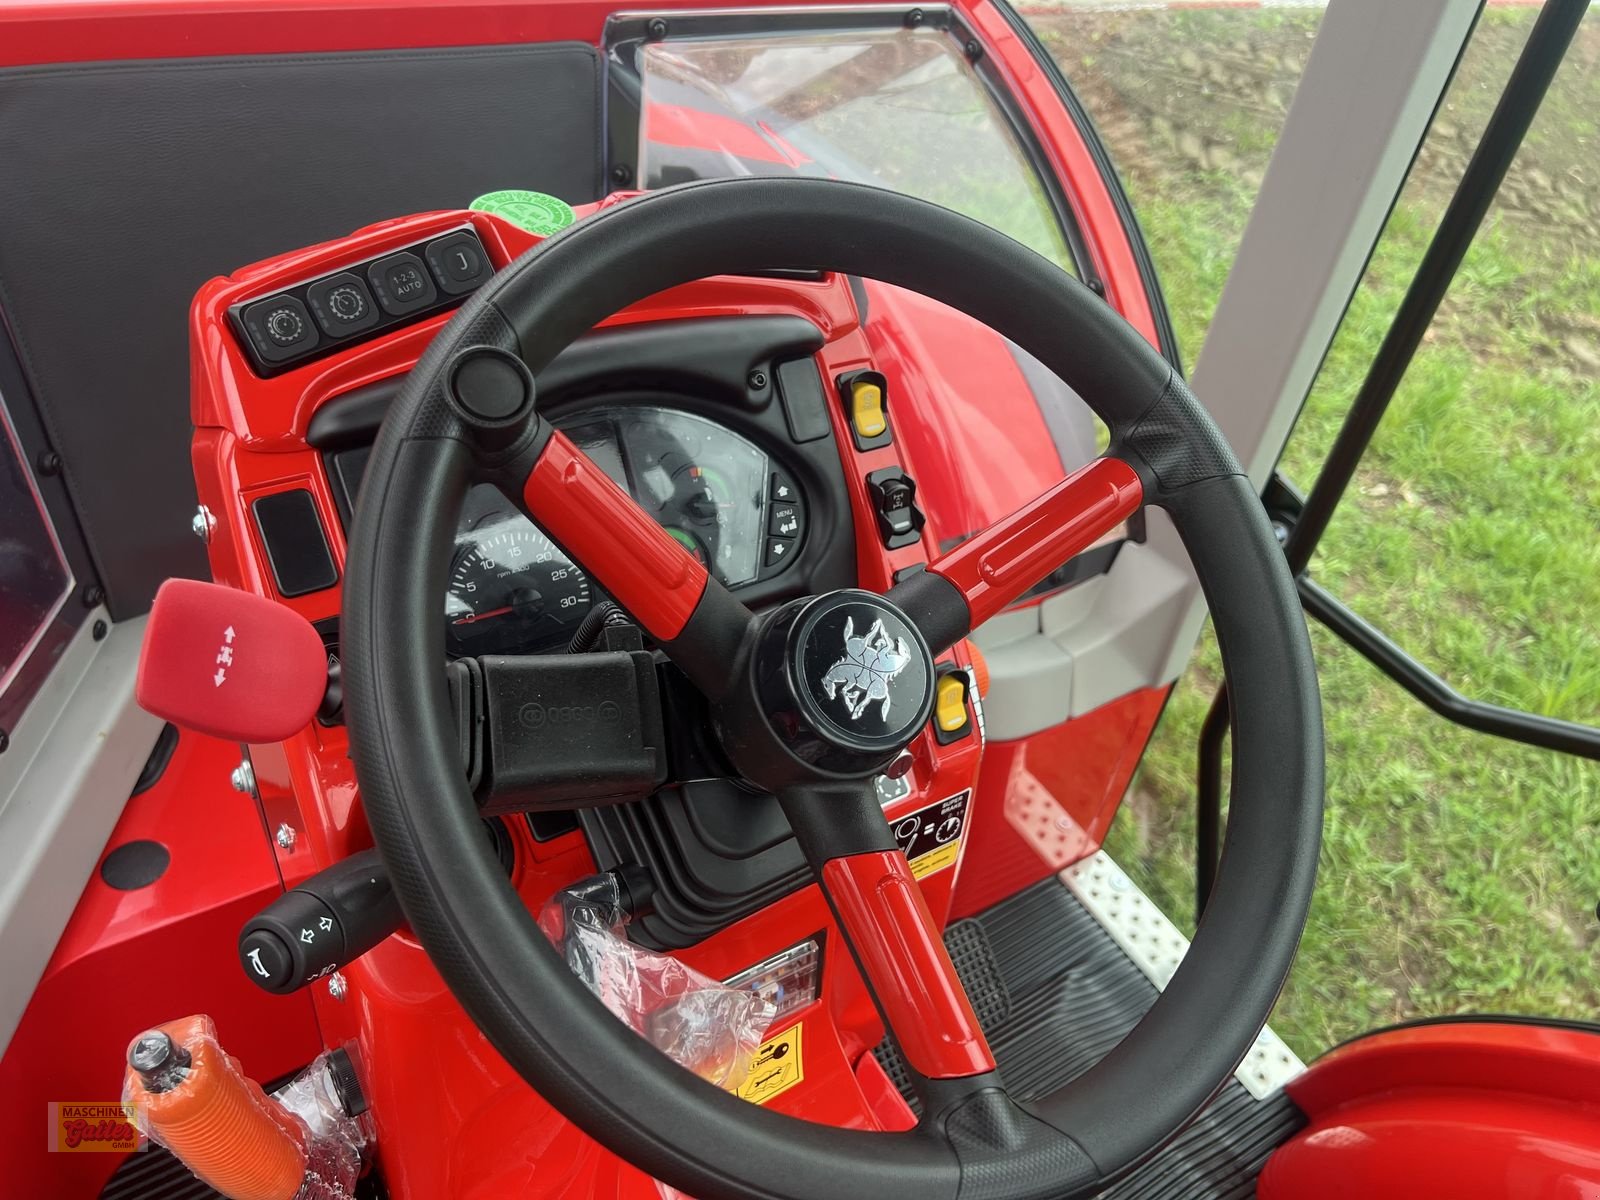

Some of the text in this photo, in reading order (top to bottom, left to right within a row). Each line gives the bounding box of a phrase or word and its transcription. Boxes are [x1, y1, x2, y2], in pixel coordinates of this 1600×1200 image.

[397, 280, 422, 296] AUTO
[776, 508, 793, 519] MENU
[507, 546, 522, 558] 15
[536, 551, 552, 563] 20
[480, 559, 496, 571] 10
[551, 568, 568, 581] 25
[466, 581, 477, 593] 5
[560, 595, 577, 609] 30
[942, 795, 964, 809] SUPER
[940, 801, 962, 816] BRAKE
